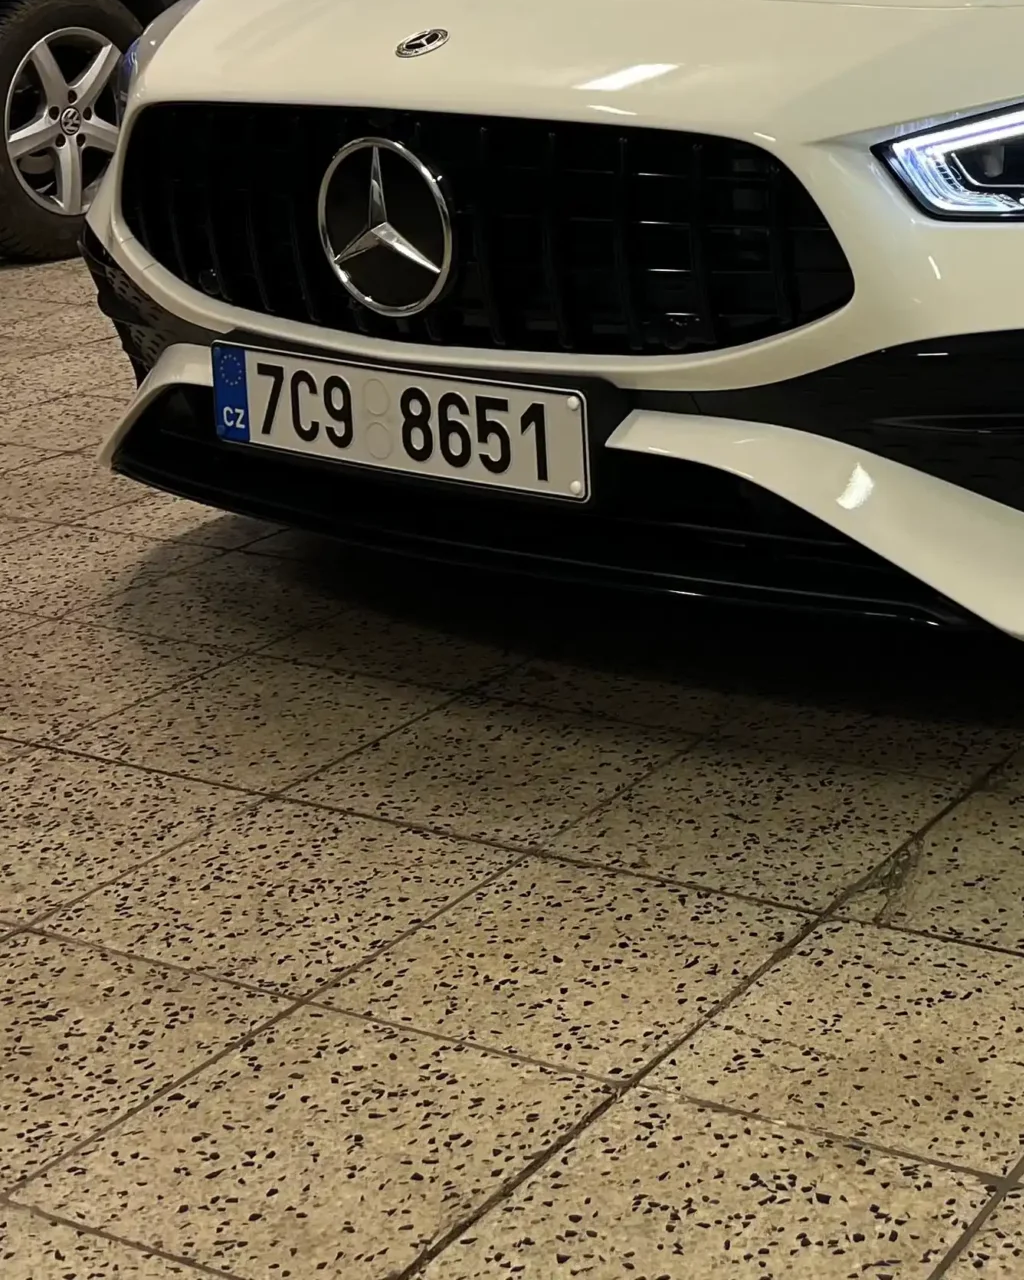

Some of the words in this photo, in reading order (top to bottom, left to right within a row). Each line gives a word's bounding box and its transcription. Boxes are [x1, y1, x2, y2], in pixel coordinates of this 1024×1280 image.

[223, 406, 245, 428] CZ
[256, 362, 354, 449] 7C9
[399, 386, 549, 482] 8651
